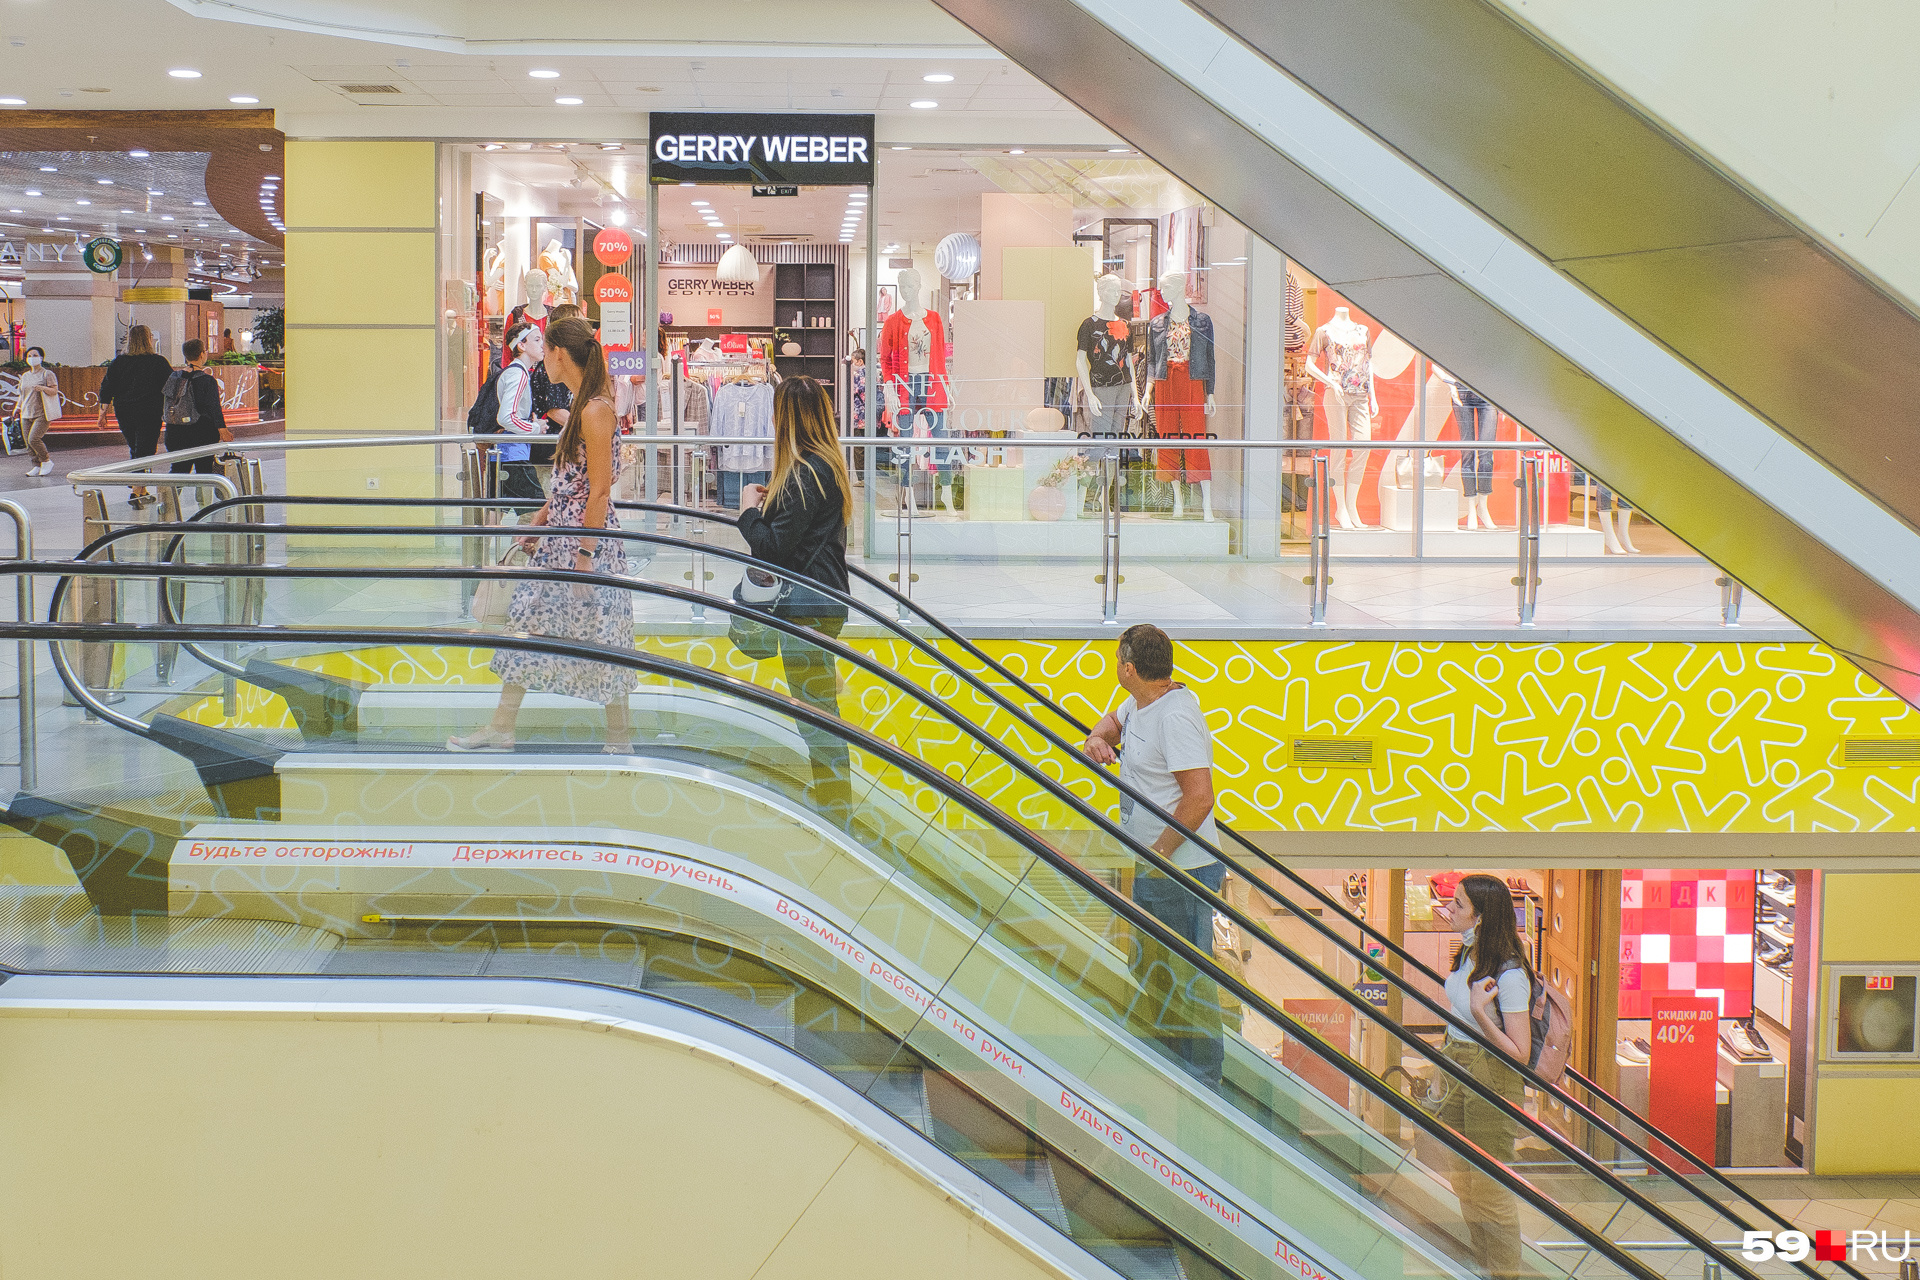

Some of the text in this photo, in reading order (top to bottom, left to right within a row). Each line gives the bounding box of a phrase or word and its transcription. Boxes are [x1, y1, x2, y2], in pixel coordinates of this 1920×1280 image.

[655, 134, 869, 163] GERRY WEBER
[599, 242, 628, 252] 70%
[92, 262, 117, 272] COMPANY
[600, 287, 628, 298] 50%
[668, 279, 755, 290] GERRY WEBER
[892, 373, 964, 397] NEW
[891, 406, 1028, 431] COLOUR
[189, 842, 413, 862] Будьте осторожны!
[452, 845, 739, 894] Держитесь за поручень.
[776, 899, 1027, 1079] Возьмите ребенка на руки.
[1330, 1013, 1345, 1024] ДО
[1657, 1010, 1714, 1021] СКИДКИ ДО
[1656, 1024, 1695, 1043] 40%
[1060, 1090, 1241, 1228] Будьте осторожны!
